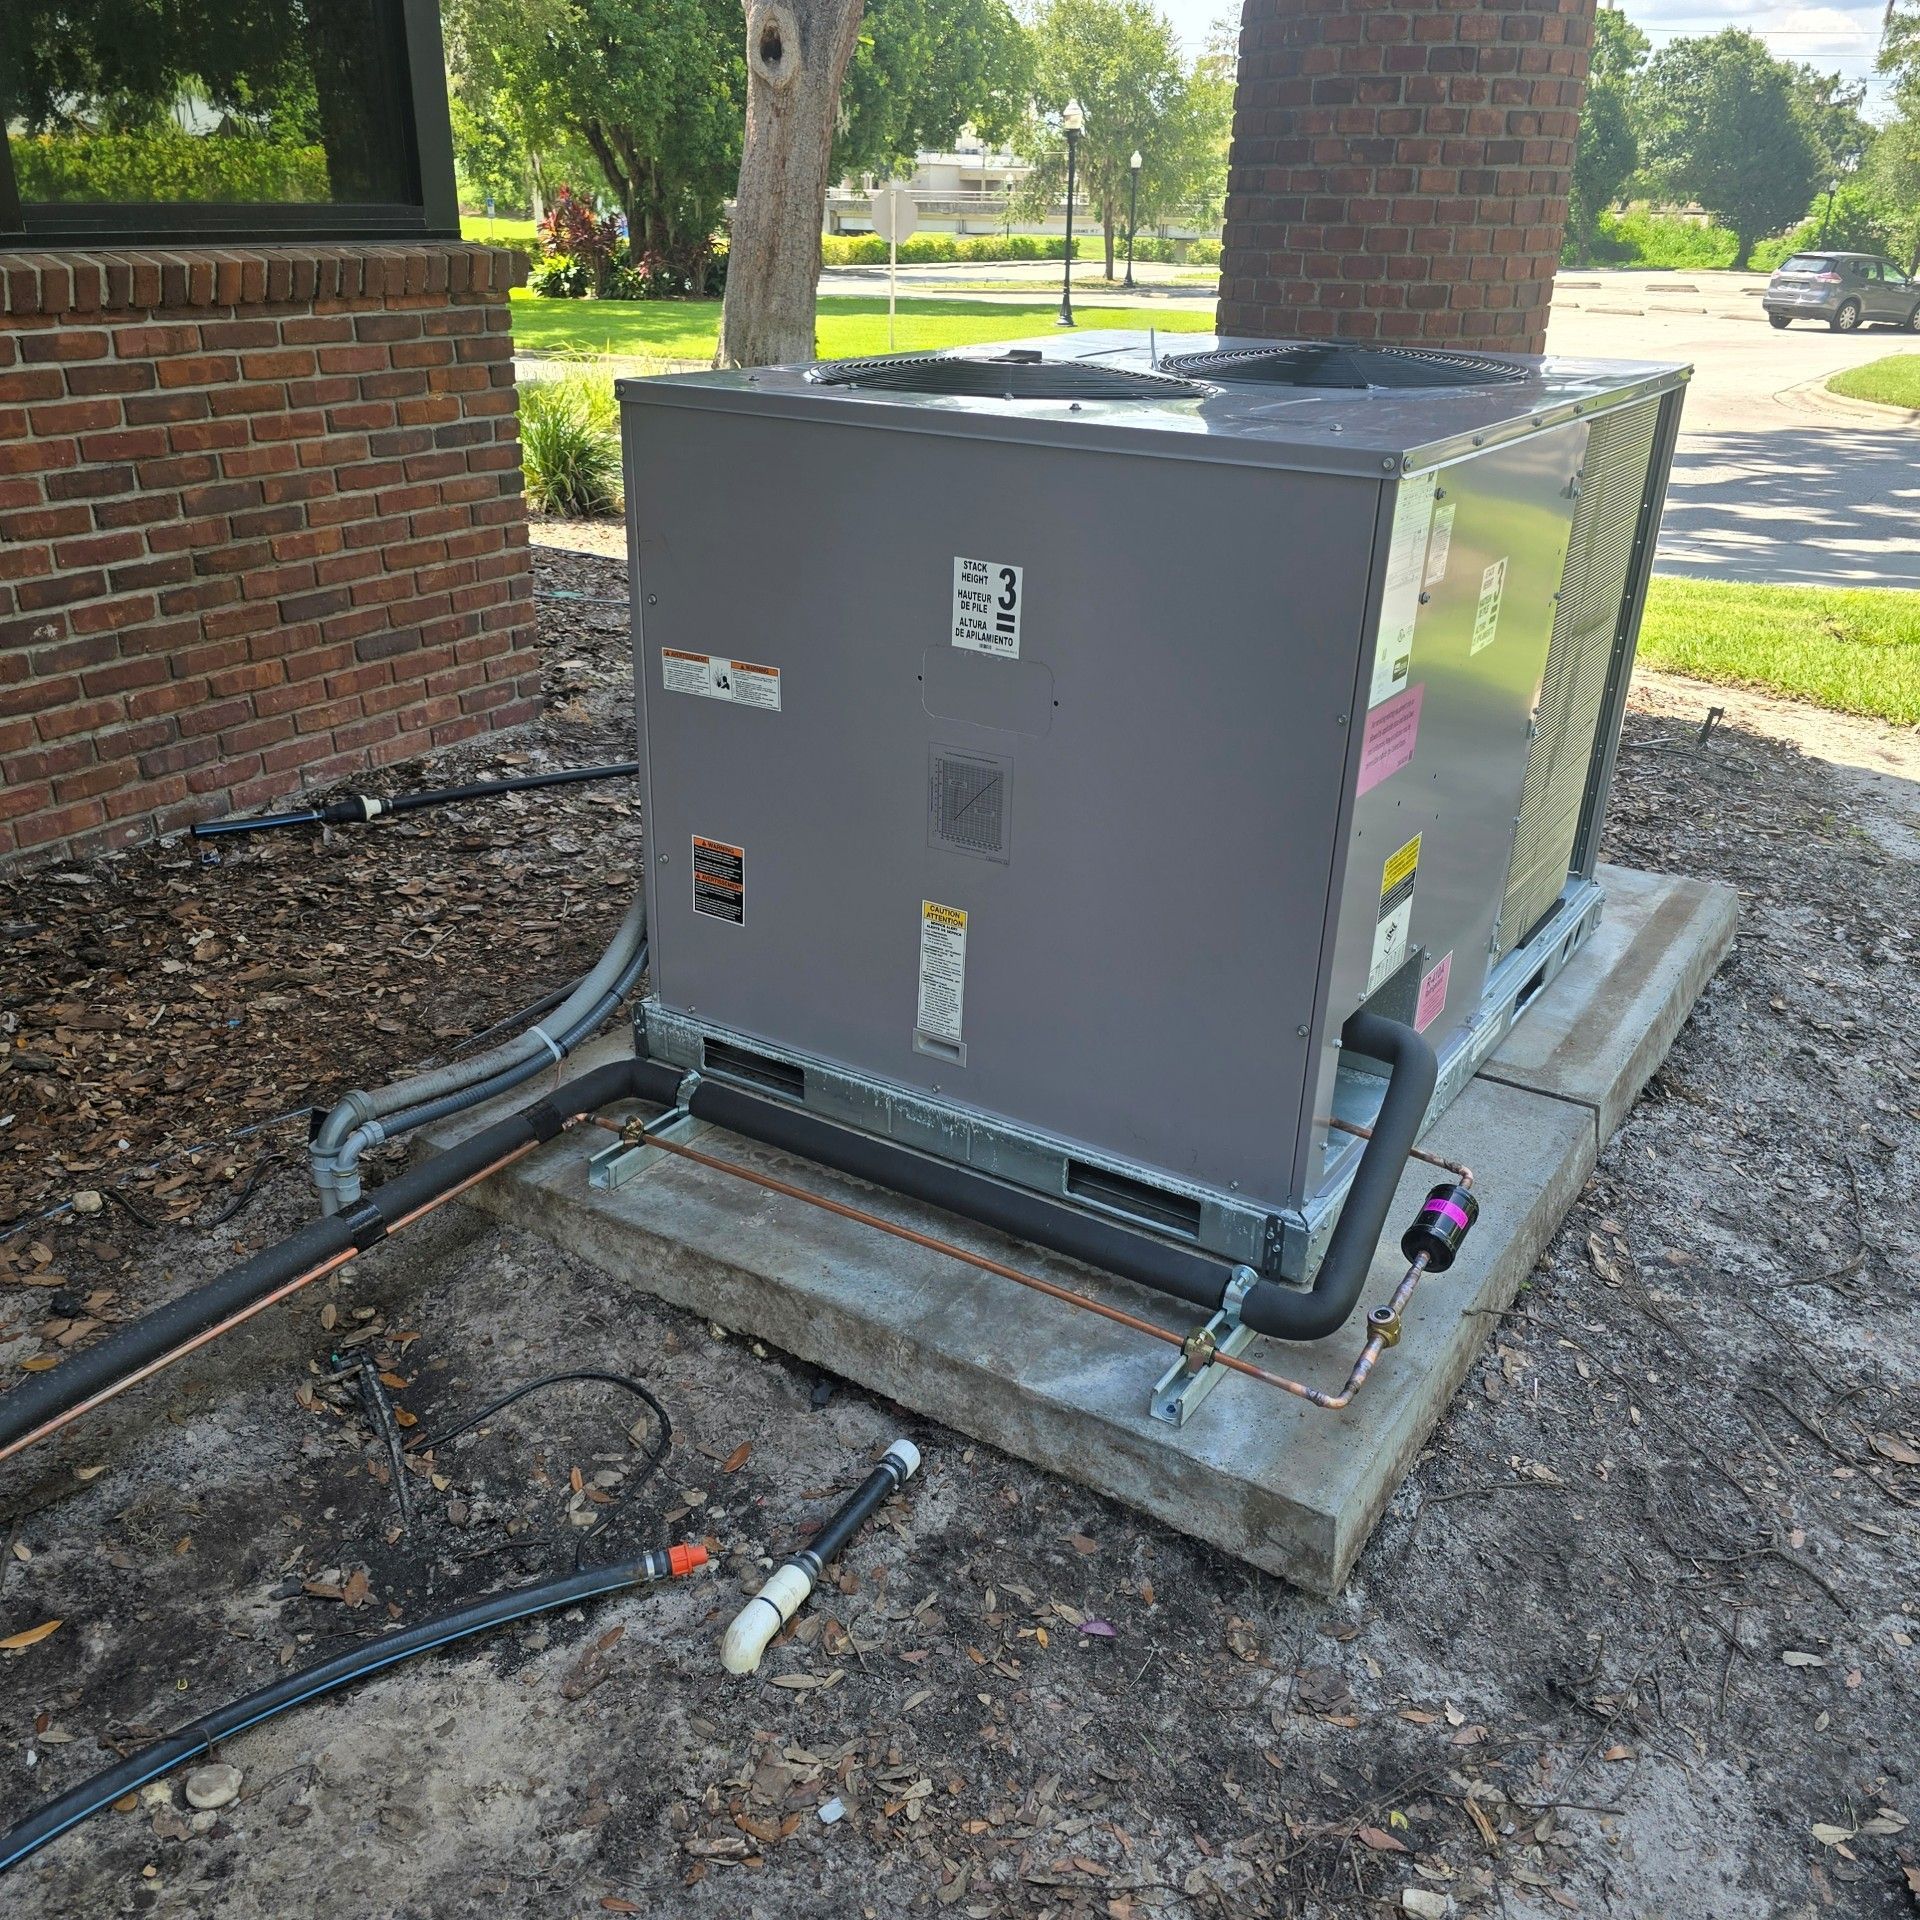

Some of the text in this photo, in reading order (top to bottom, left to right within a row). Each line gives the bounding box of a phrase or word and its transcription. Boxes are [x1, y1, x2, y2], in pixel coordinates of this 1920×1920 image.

[963, 560, 988, 573] STACK
[961, 572, 989, 585] HEIGHT
[957, 589, 992, 604] HAUTEUR
[998, 568, 1017, 611] 3
[960, 600, 988, 614] DE PILE
[959, 617, 988, 630] ALTURA
[955, 628, 964, 638] DE
[965, 629, 1014, 647] APILAMIENTO
[707, 841, 735, 855] WARNING
[702, 874, 742, 891] AVERTISSEMENT
[930, 905, 960, 919] CAUTION
[926, 912, 963, 927] ATTENTION
